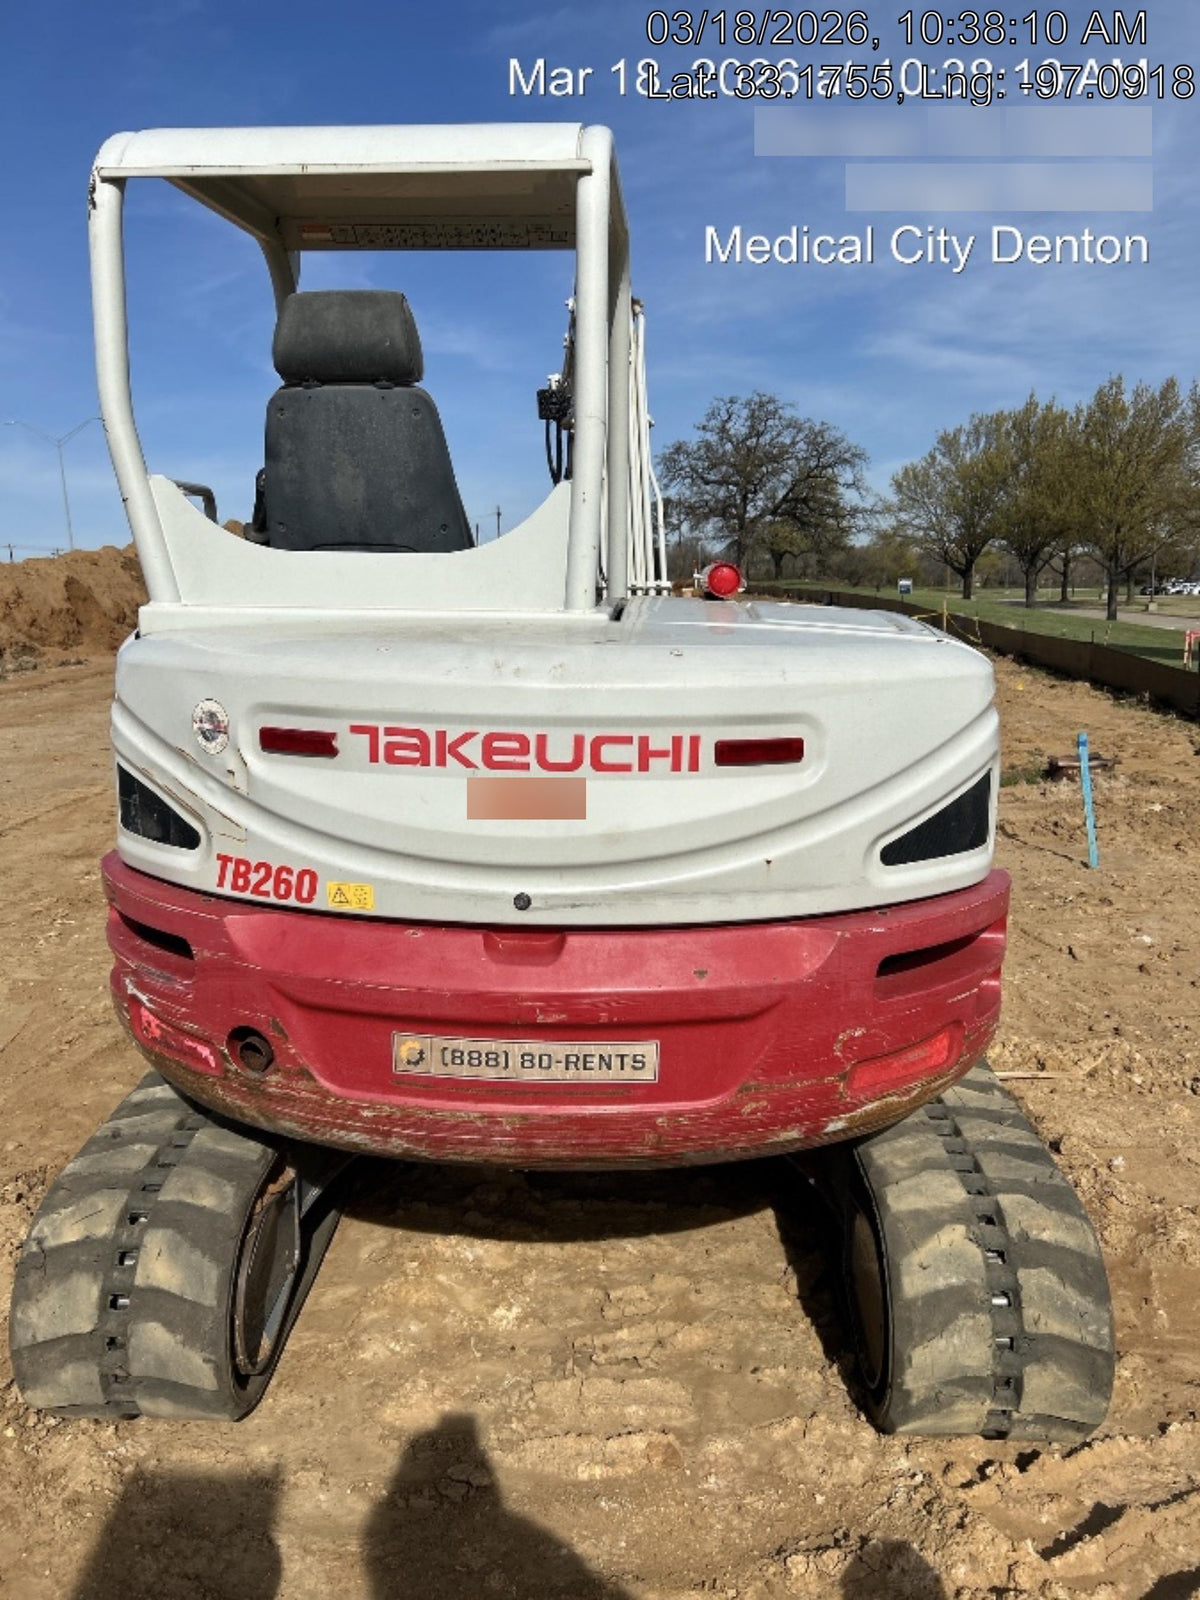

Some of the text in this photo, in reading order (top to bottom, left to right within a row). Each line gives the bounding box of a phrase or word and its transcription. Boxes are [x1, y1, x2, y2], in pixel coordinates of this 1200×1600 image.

[216, 853, 319, 904] TB260
[441, 1047, 647, 1072] (888) 80-RENTS
